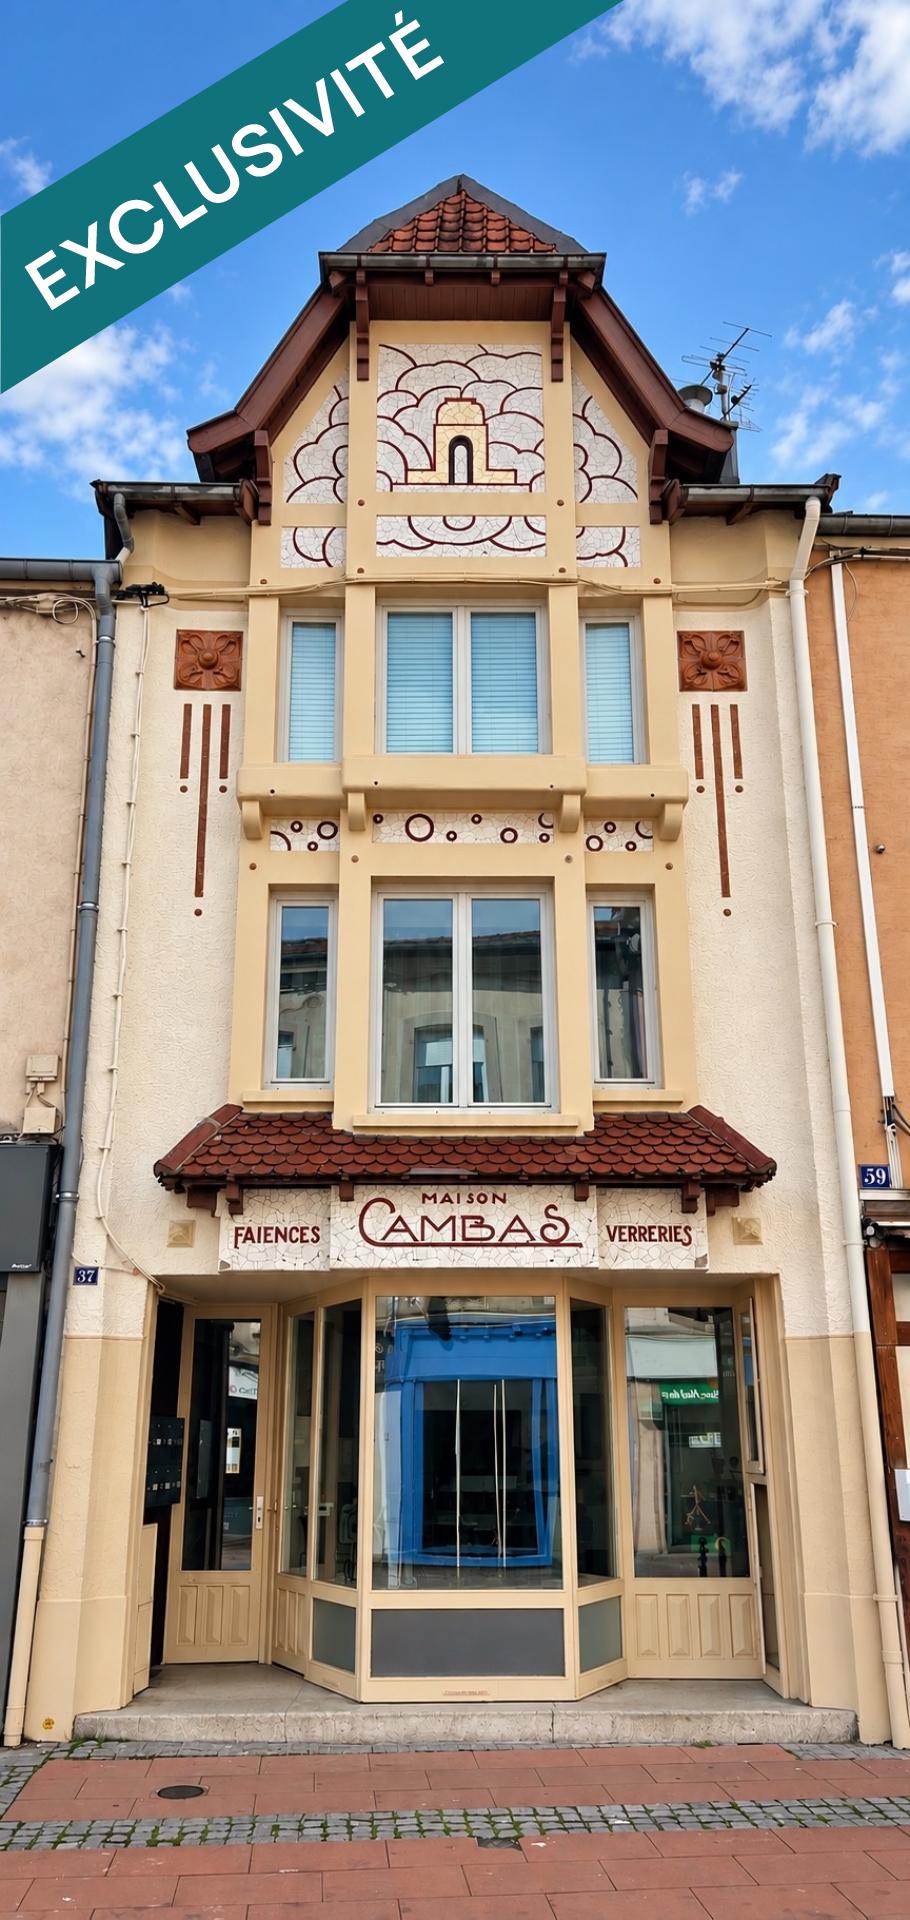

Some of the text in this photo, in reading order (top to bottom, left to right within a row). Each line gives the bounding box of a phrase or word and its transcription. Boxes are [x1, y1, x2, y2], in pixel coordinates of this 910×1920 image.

[864, 1168, 887, 1185] 59
[421, 1192, 507, 1205] MAISON
[358, 1197, 584, 1248] CAMBAS
[234, 1225, 321, 1249] FAIENCES
[606, 1224, 693, 1247] VERRERIES
[77, 1270, 96, 1283] 37
